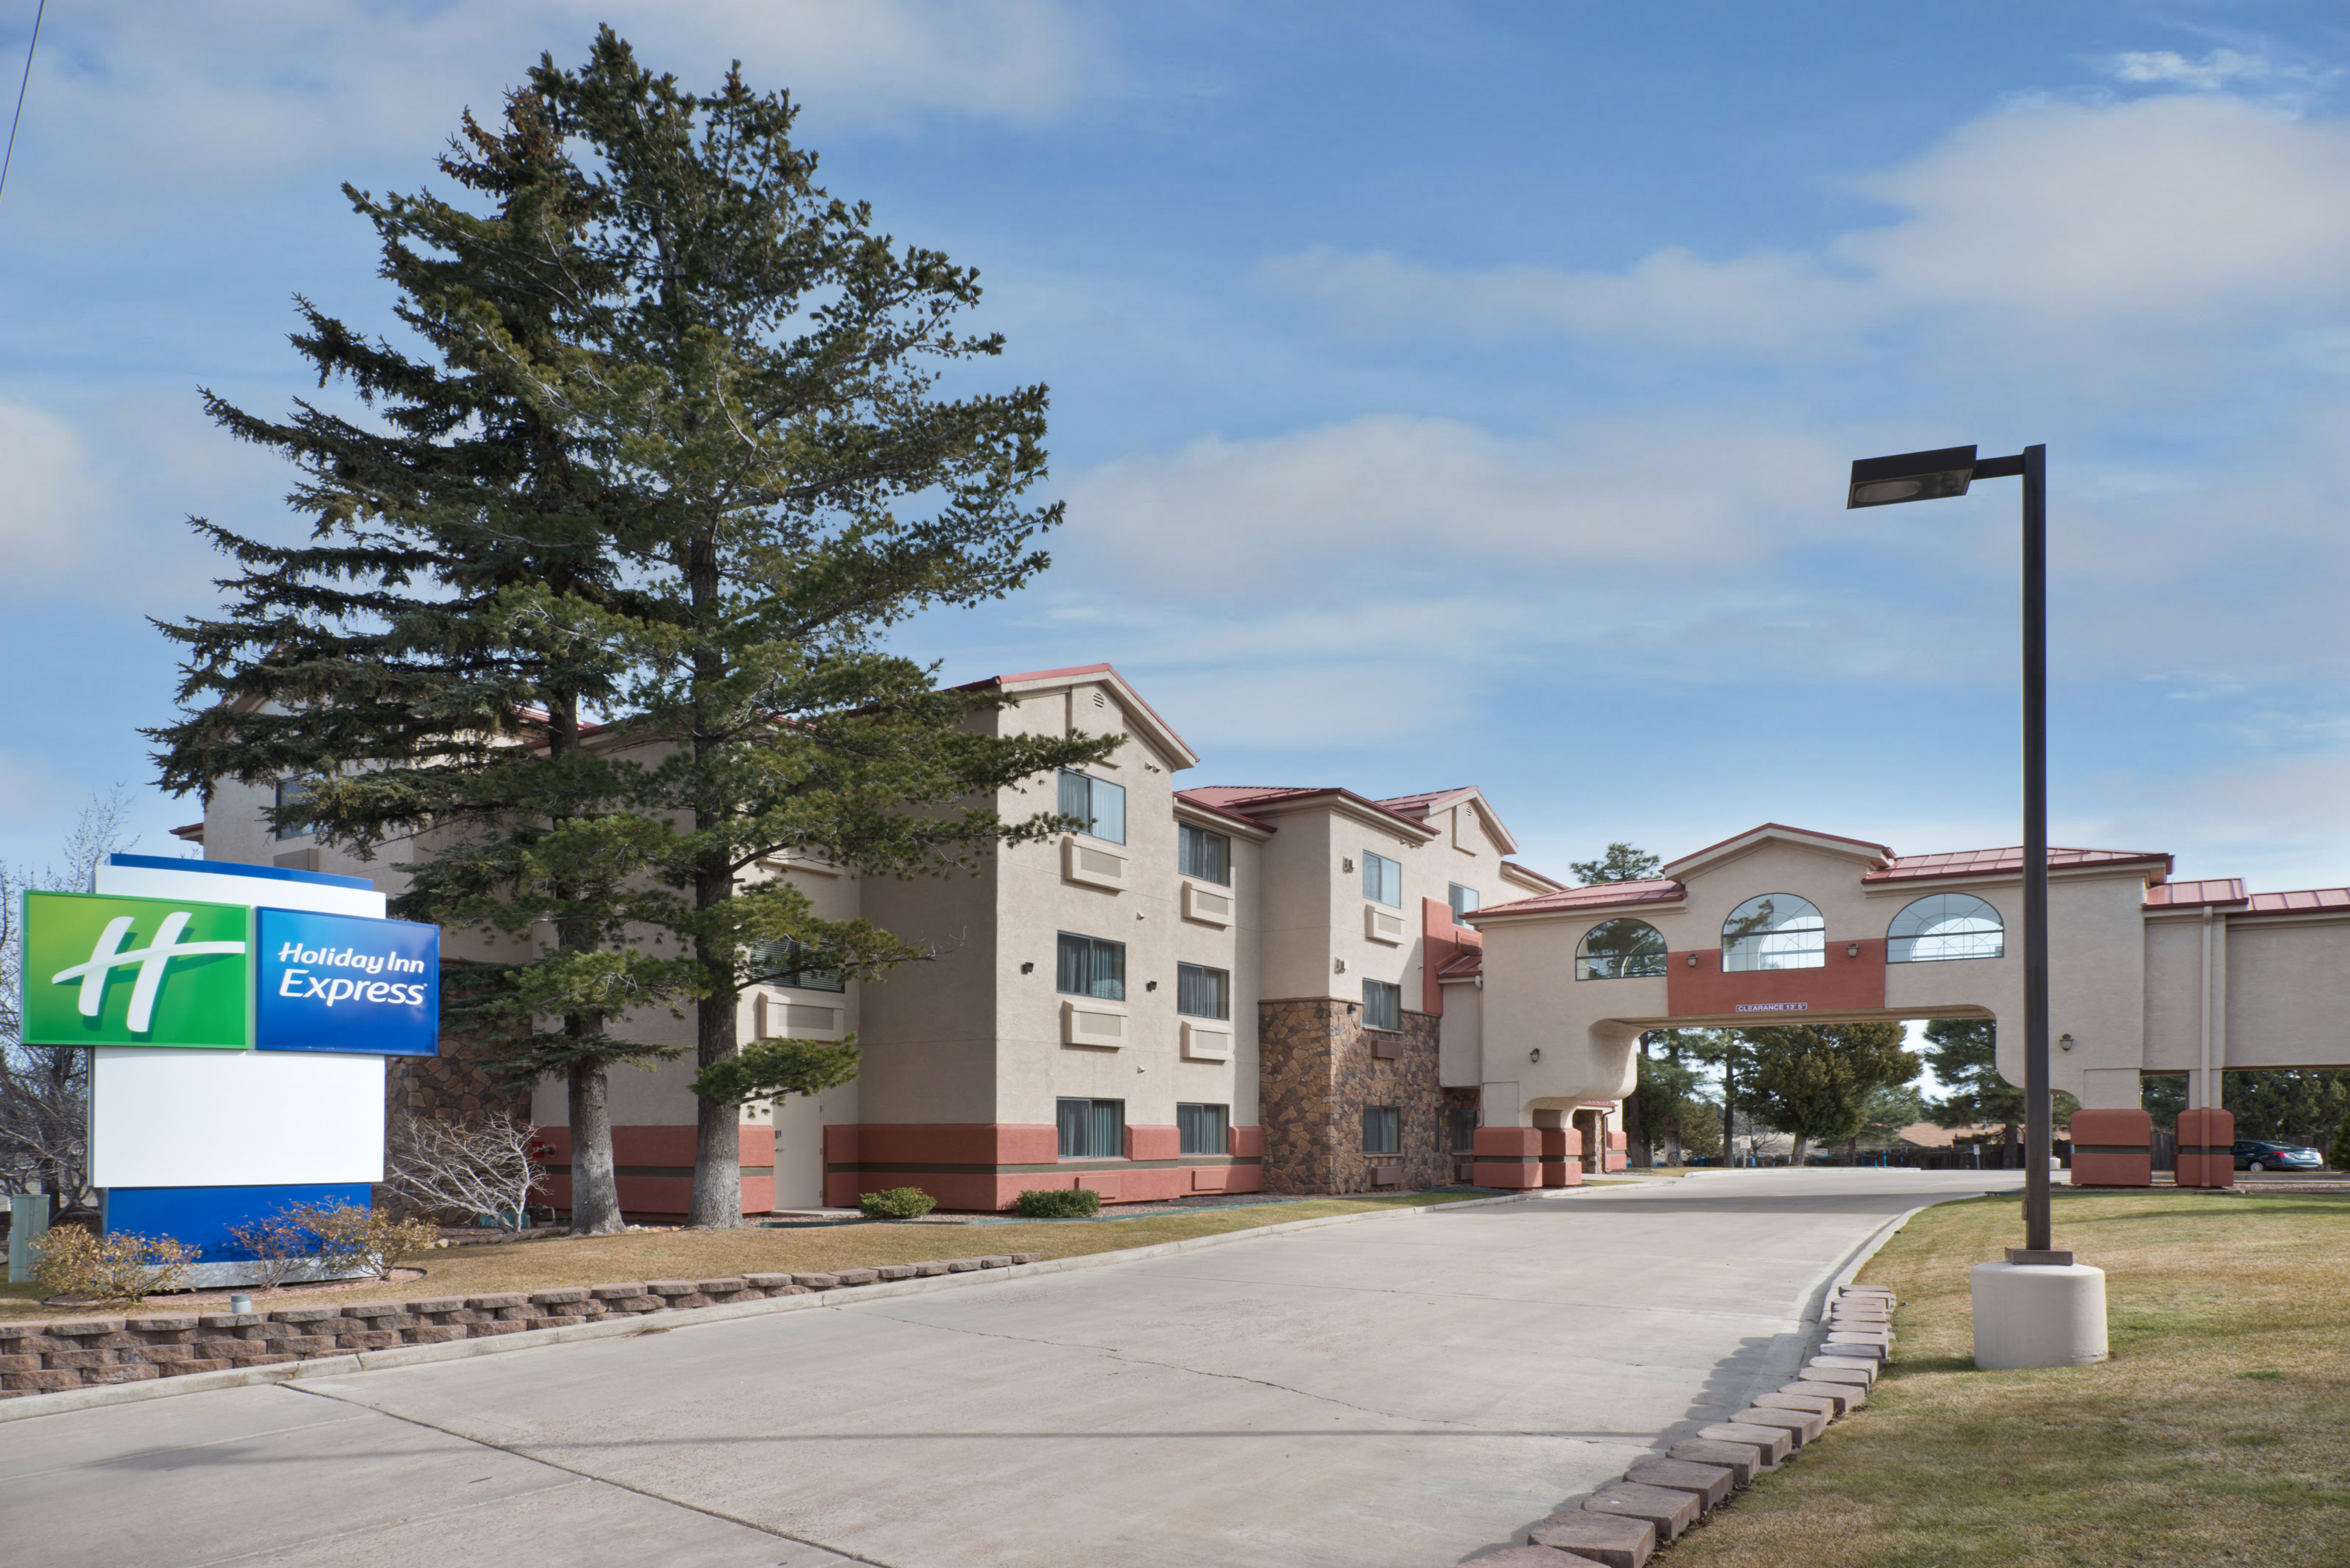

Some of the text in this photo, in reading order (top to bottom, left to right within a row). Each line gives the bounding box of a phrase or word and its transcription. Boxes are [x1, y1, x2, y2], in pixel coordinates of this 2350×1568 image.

[278, 942, 424, 974] Holiday Inn
[279, 969, 425, 1007] Express
